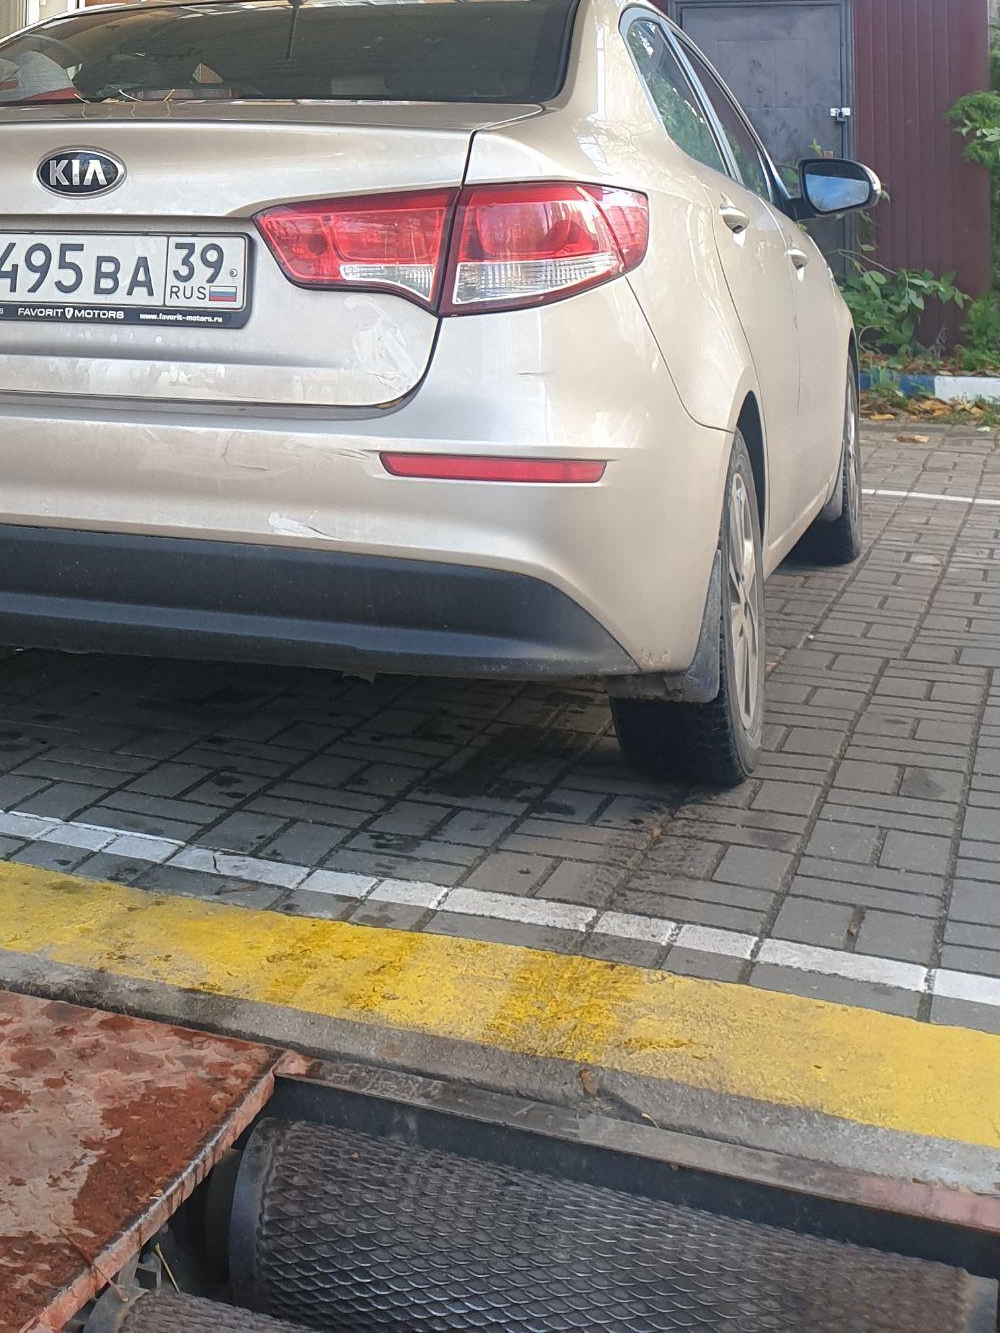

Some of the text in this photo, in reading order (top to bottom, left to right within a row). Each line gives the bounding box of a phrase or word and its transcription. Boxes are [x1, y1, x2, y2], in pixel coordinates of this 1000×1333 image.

[49, 159, 108, 186] KIA
[172, 242, 225, 284] 39
[169, 284, 207, 301] RUS
[18, 307, 125, 320] FAVORIT MOTORS
[139, 312, 223, 323] www.favorit-motors.ru
